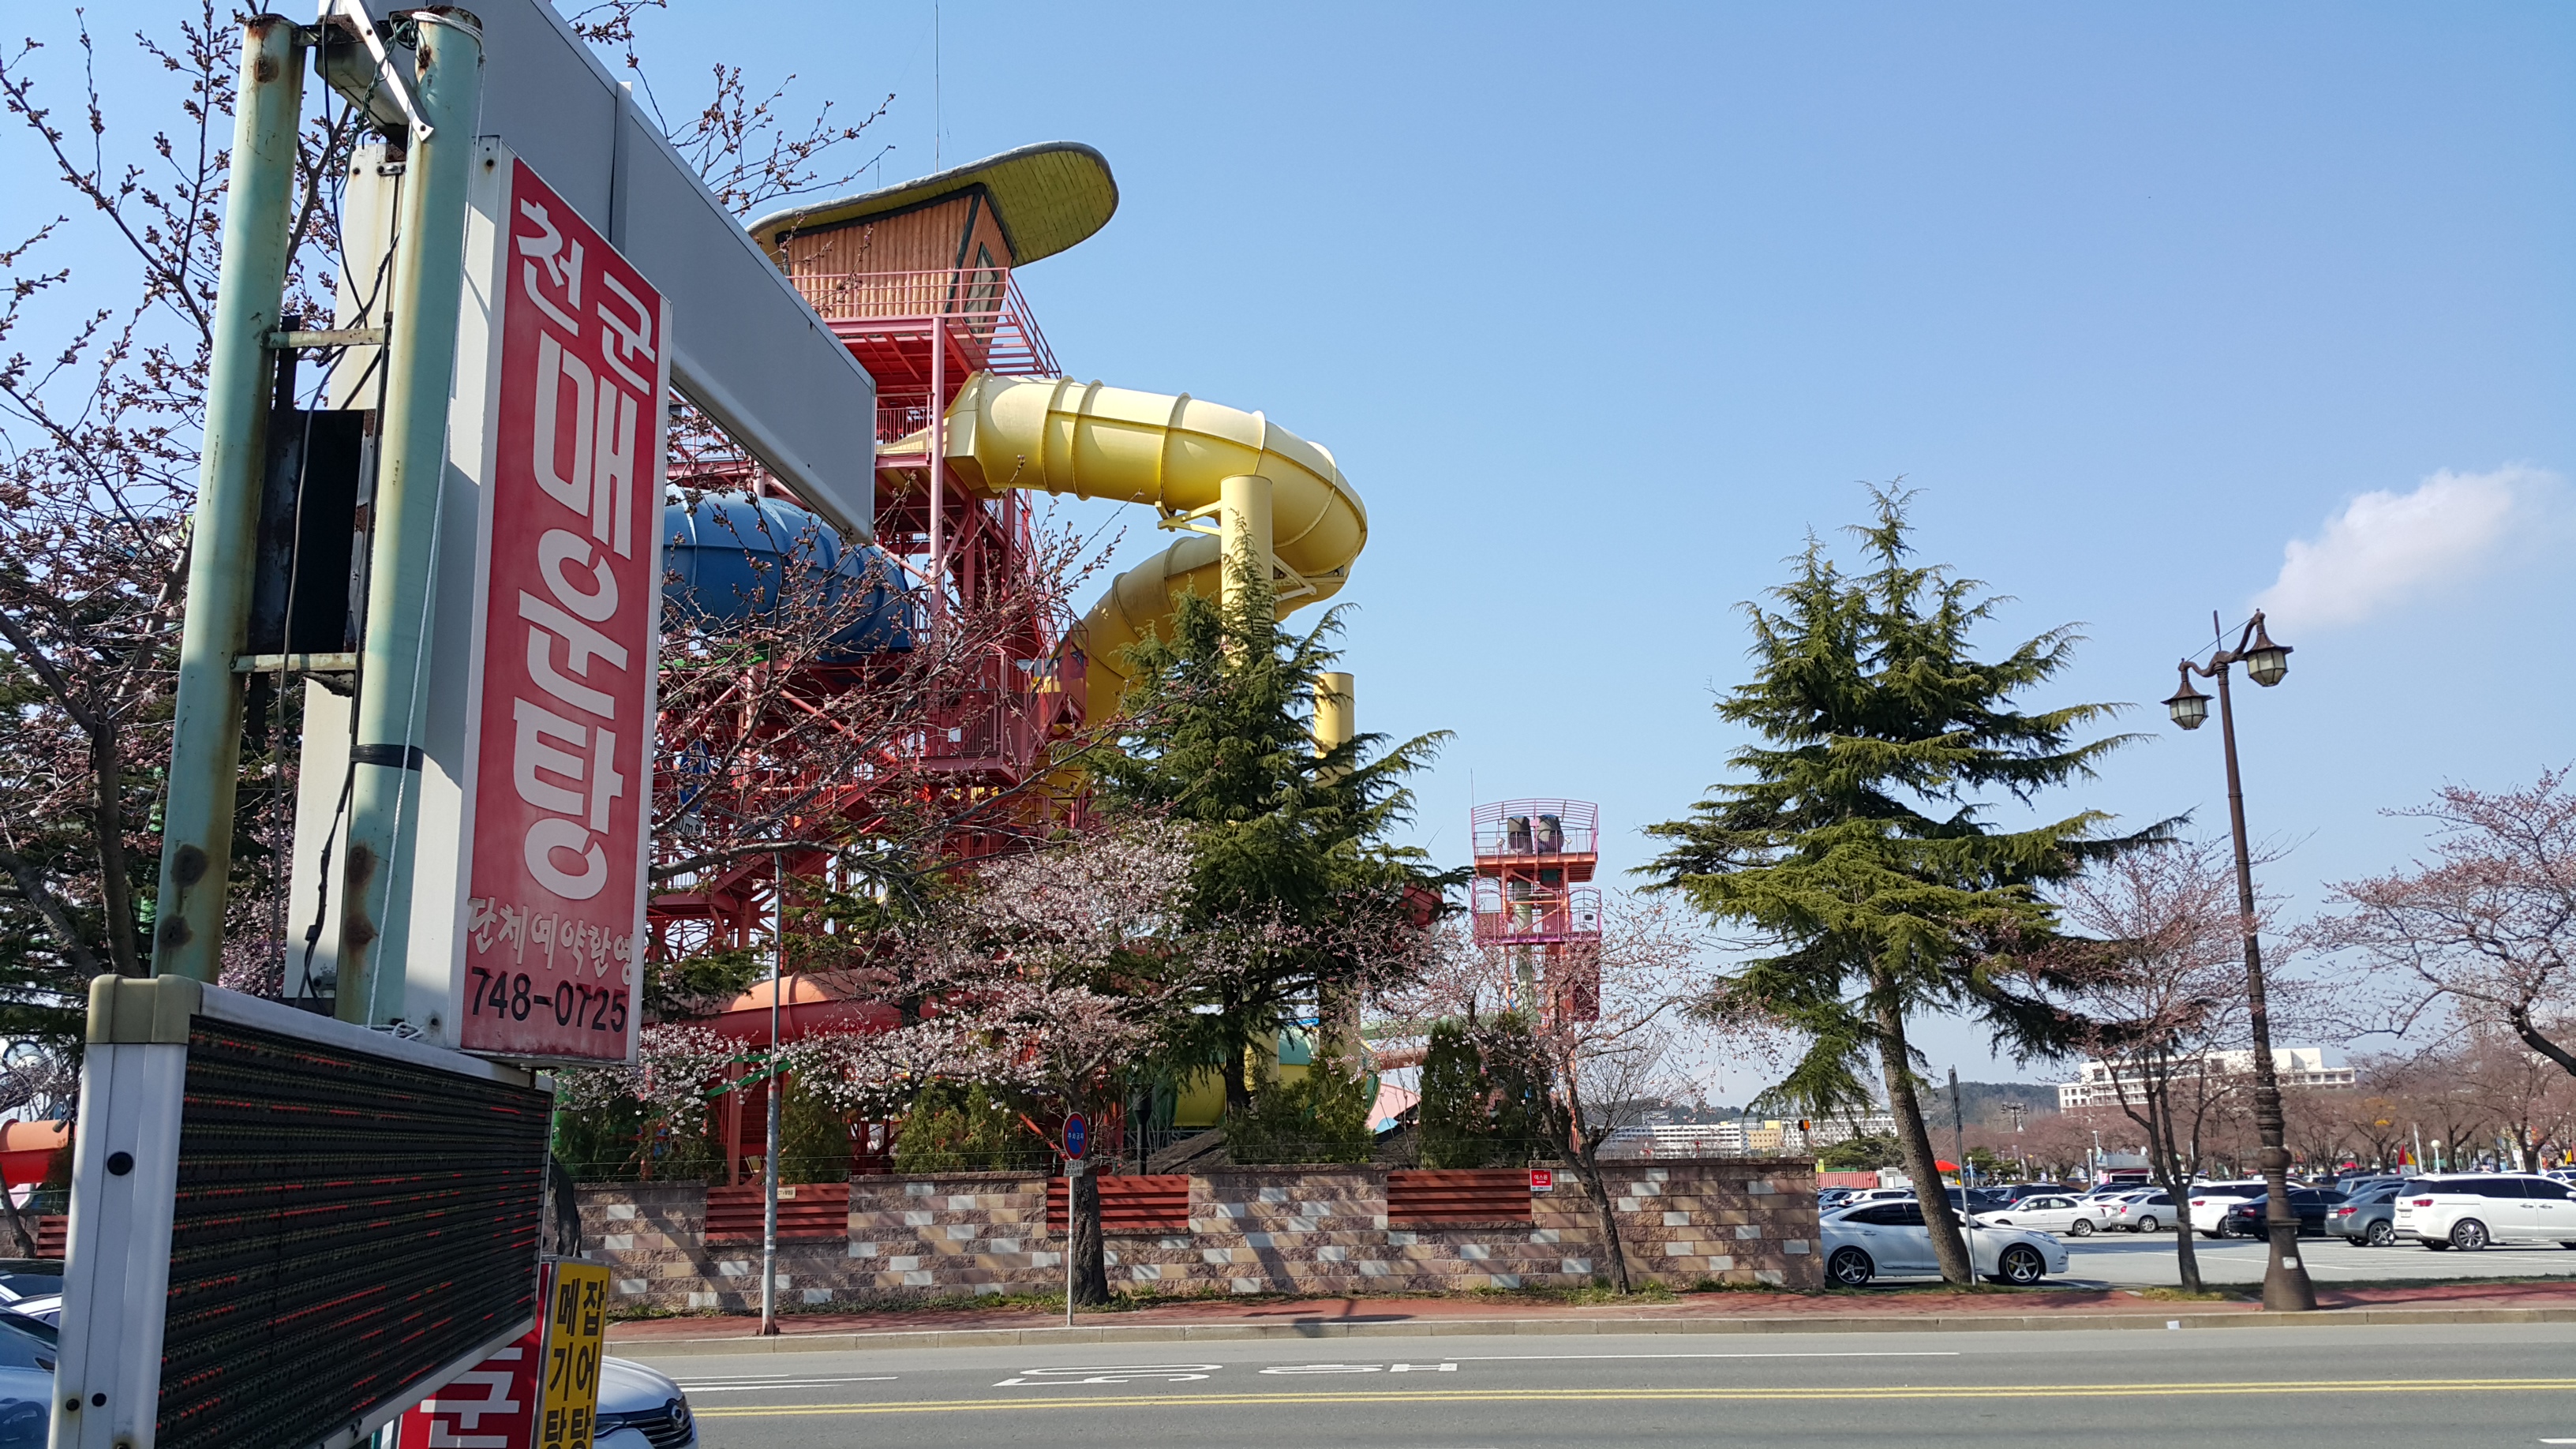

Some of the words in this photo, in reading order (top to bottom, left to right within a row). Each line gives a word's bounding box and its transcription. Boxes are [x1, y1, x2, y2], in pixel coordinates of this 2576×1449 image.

[515, 197, 656, 396] 천군
[512, 328, 638, 901] 매운탕
[471, 966, 628, 1033] 748-0725
